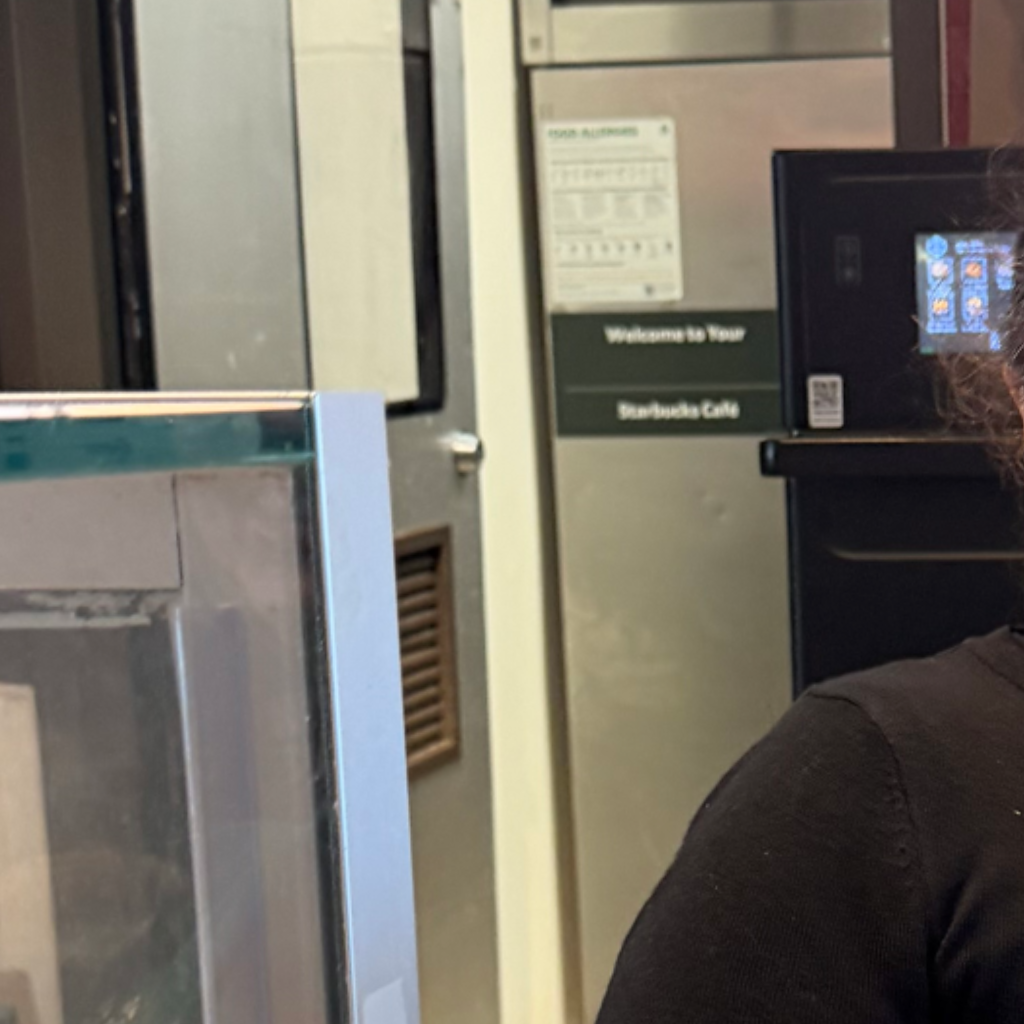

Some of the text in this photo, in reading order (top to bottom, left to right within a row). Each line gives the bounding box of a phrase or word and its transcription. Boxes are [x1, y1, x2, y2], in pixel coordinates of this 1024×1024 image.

[603, 324, 746, 344] Welcome to Your
[617, 400, 700, 420] Starbucks
